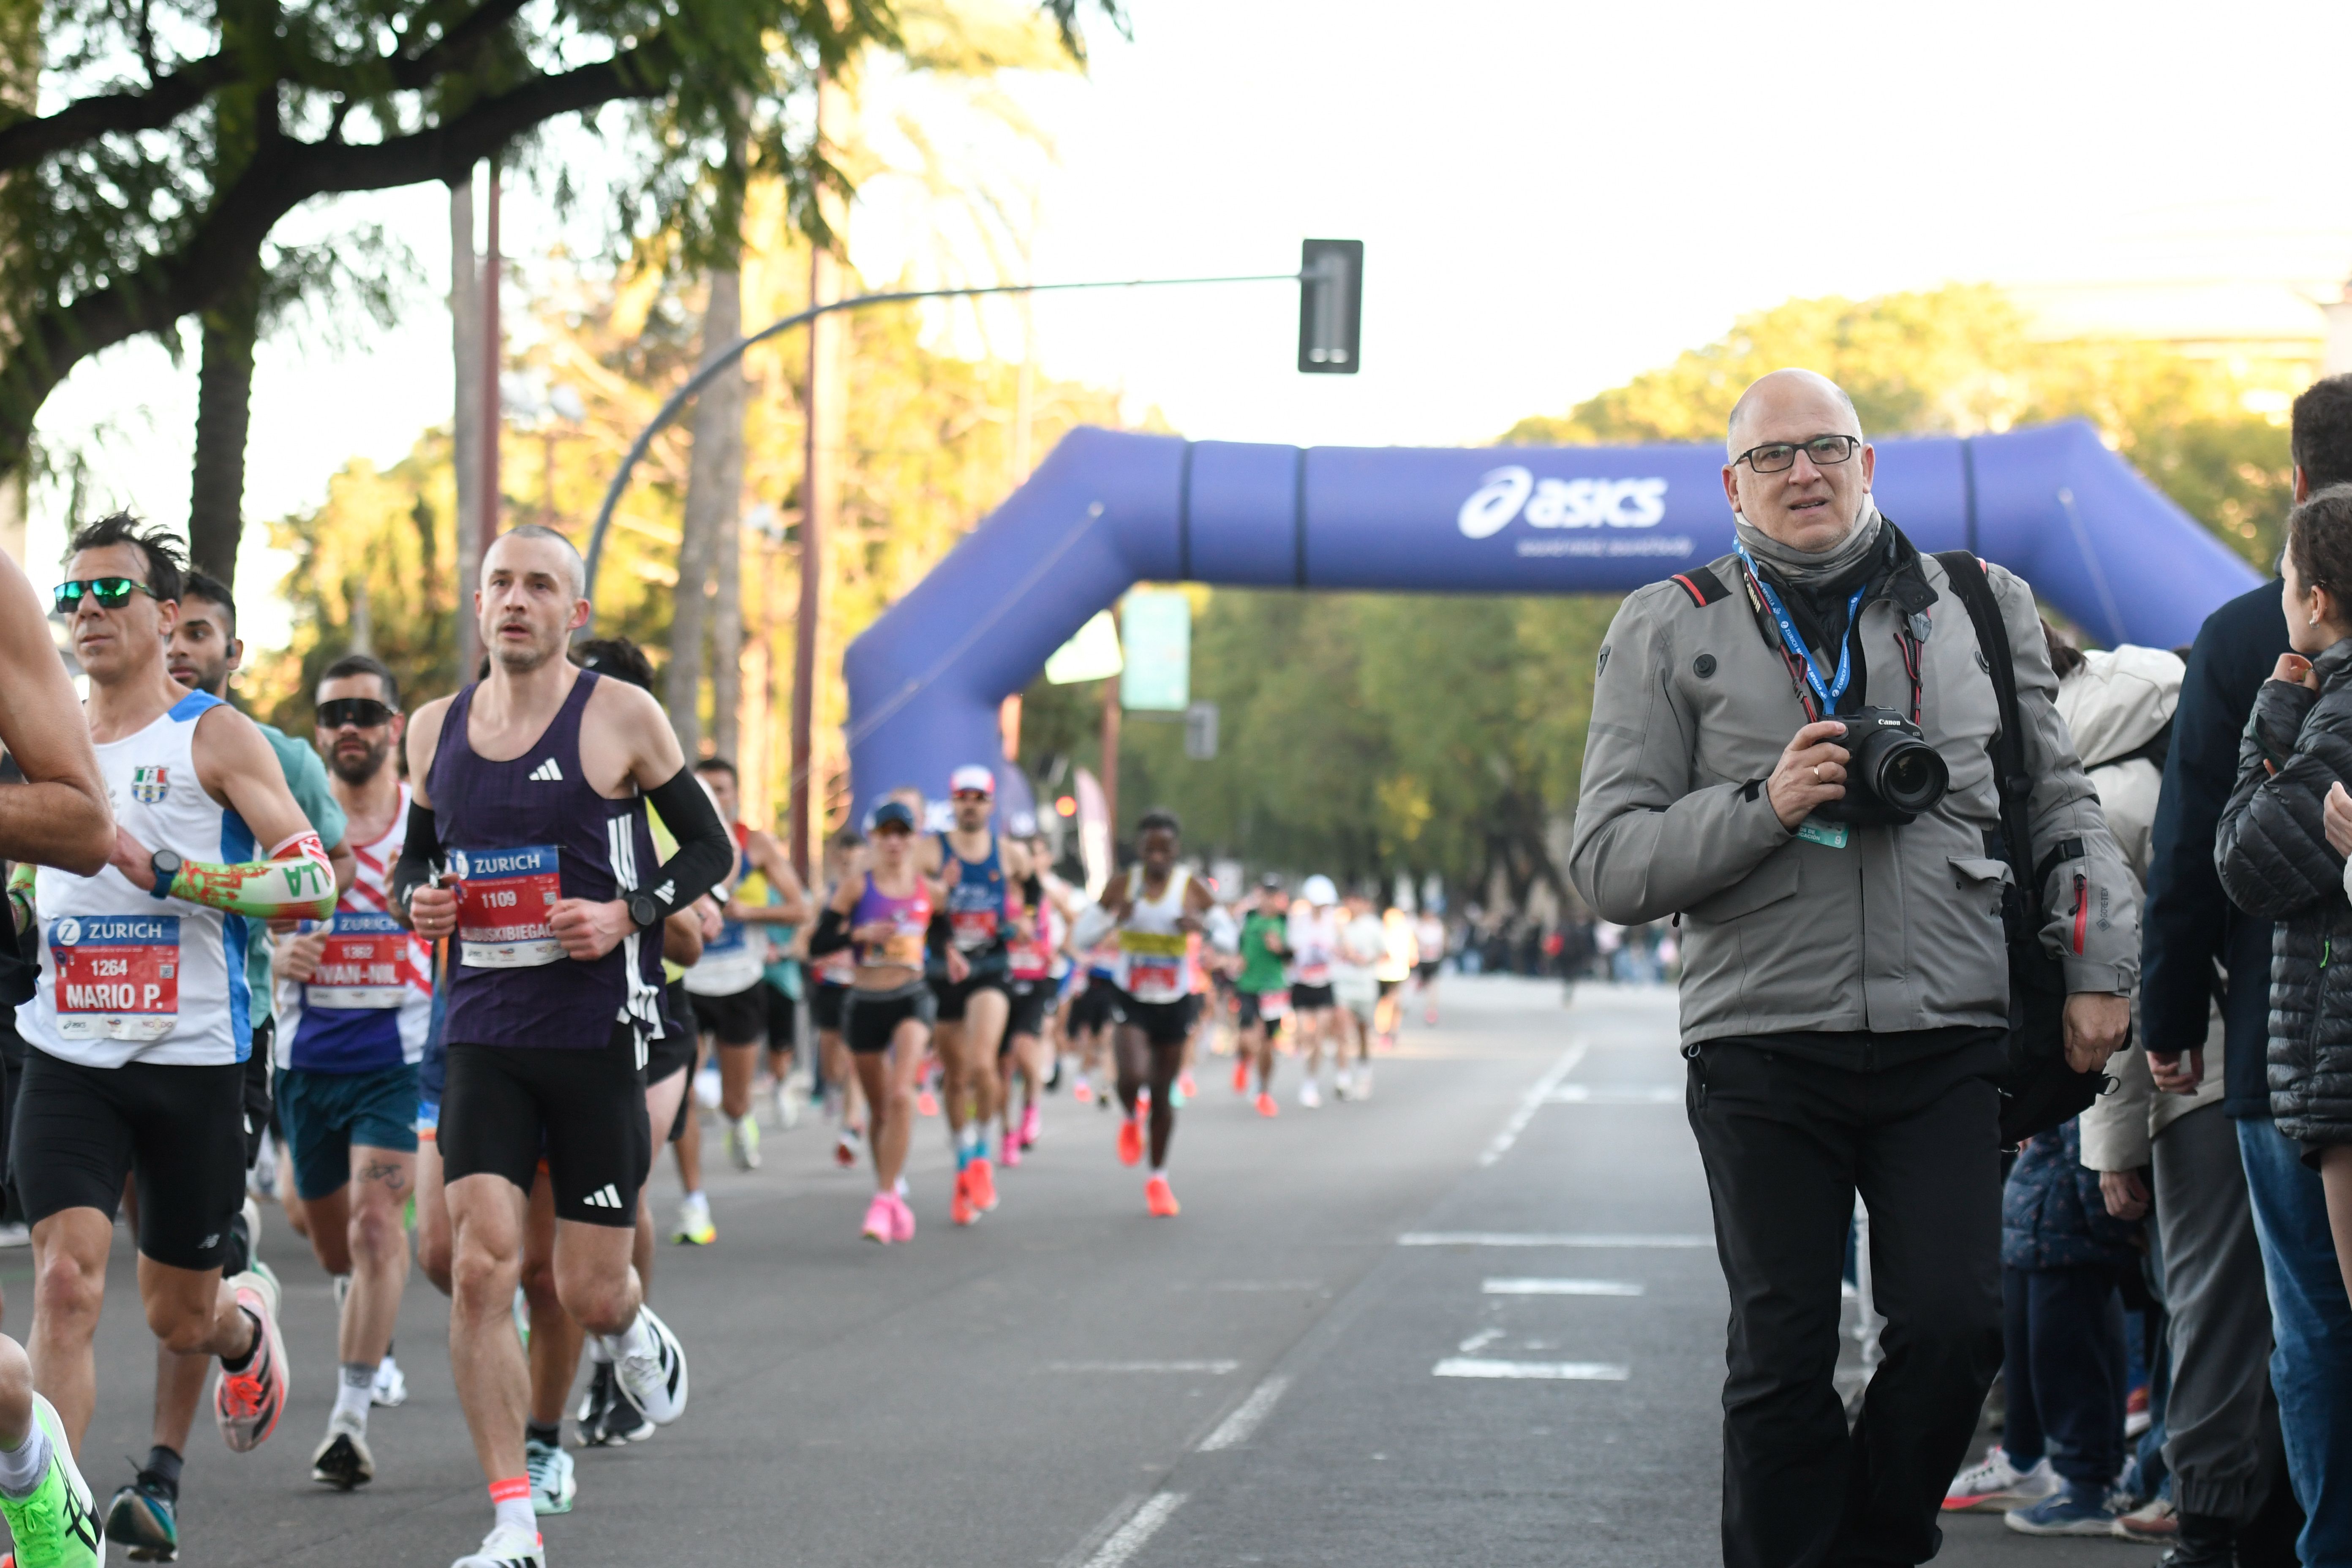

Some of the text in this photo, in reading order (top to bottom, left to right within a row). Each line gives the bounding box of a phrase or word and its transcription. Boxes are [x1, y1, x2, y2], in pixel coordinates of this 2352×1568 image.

[1524, 478, 1669, 528] asics
[1744, 572, 1761, 614] Canon
[1785, 628, 1799, 648] ZURICH
[1809, 671, 1822, 691] SEVILLA
[1837, 668, 1846, 690] ZURICH
[1798, 832, 1820, 841] ICACIÓN
[1835, 835, 1842, 845] 9
[474, 854, 541, 874] ZURICH
[482, 891, 517, 909] 1109
[2100, 887, 2109, 918] GORE-TEX
[88, 923, 162, 939] ZURICH
[90, 959, 128, 977] 1264
[66, 983, 163, 1009] MARIO P.
